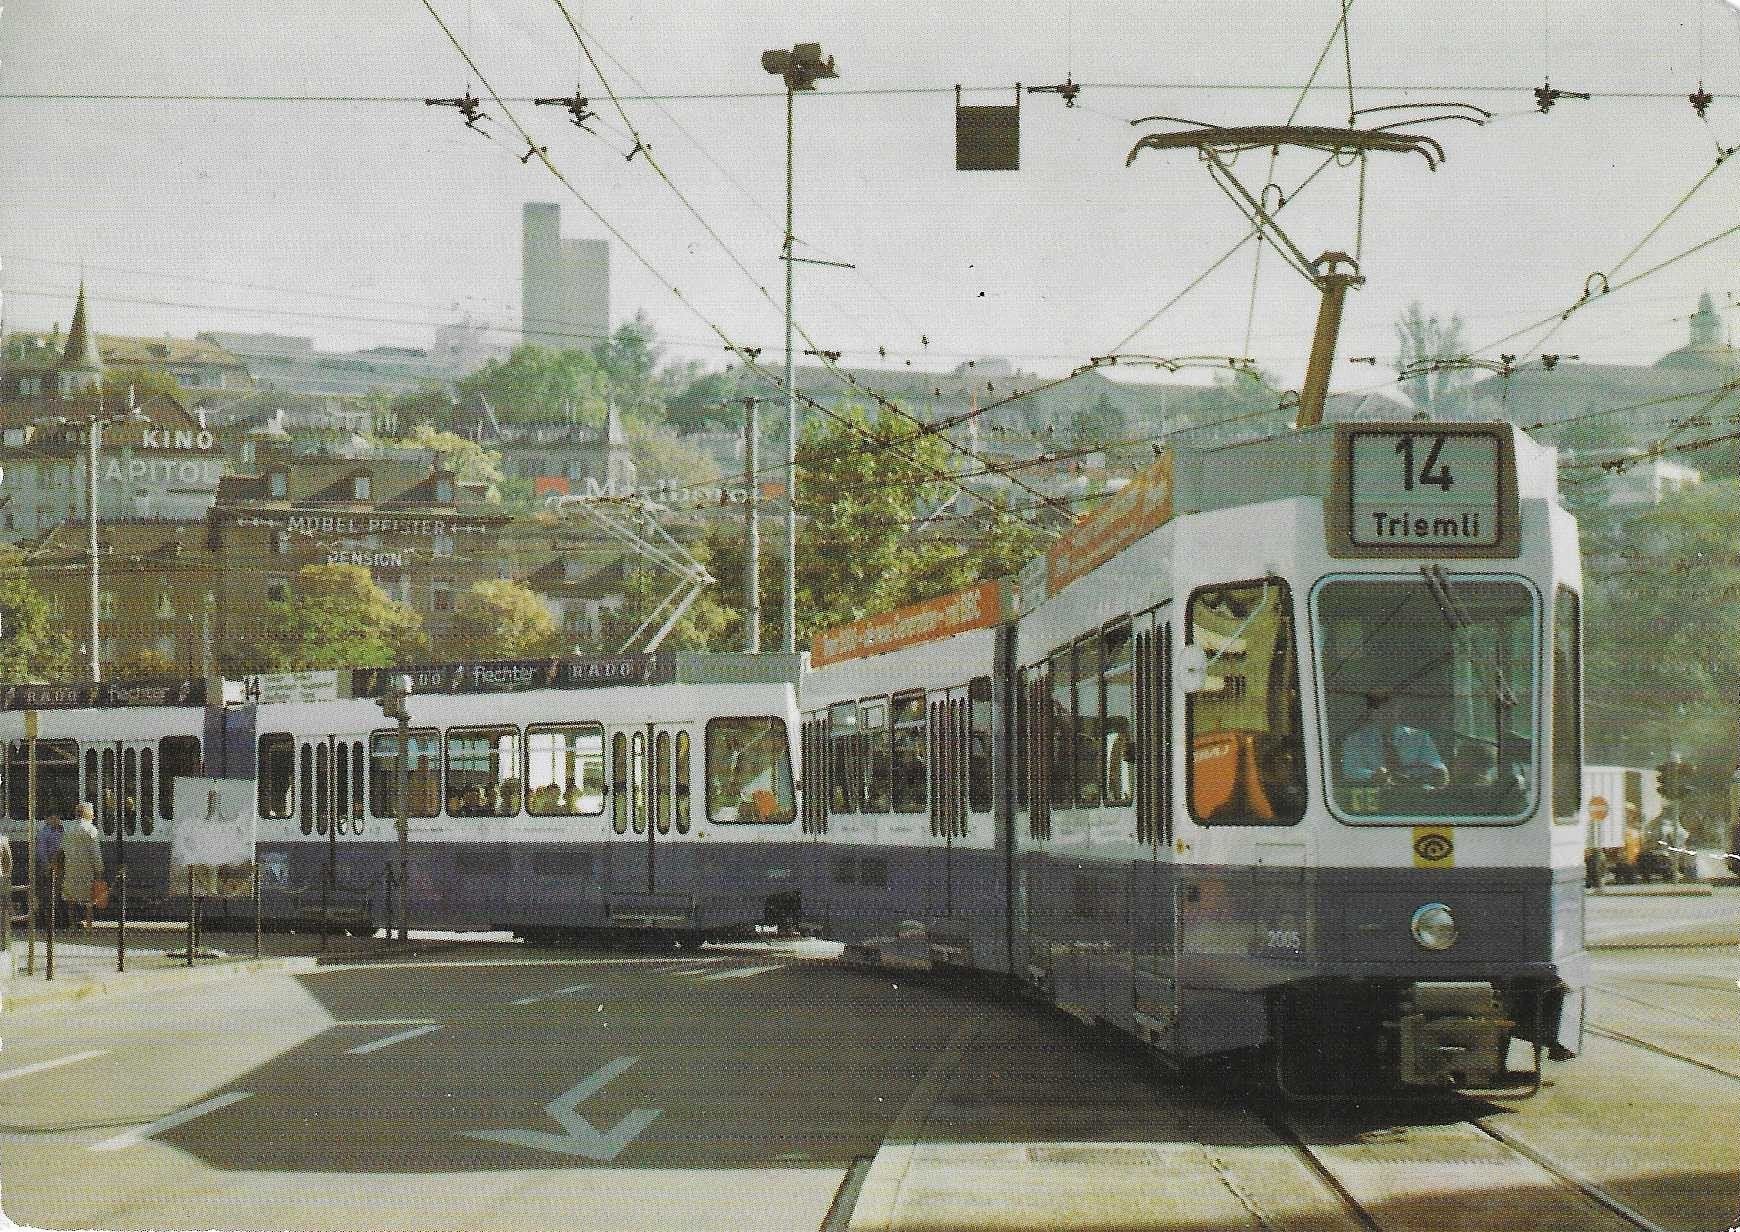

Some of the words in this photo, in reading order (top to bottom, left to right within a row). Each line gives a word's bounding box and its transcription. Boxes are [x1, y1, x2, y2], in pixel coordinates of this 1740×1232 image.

[142, 429, 213, 450] KINO
[94, 458, 220, 484] APITOL
[1394, 433, 1454, 491] 14
[1372, 511, 1479, 537] Triemli
[327, 550, 402, 567] PENSION
